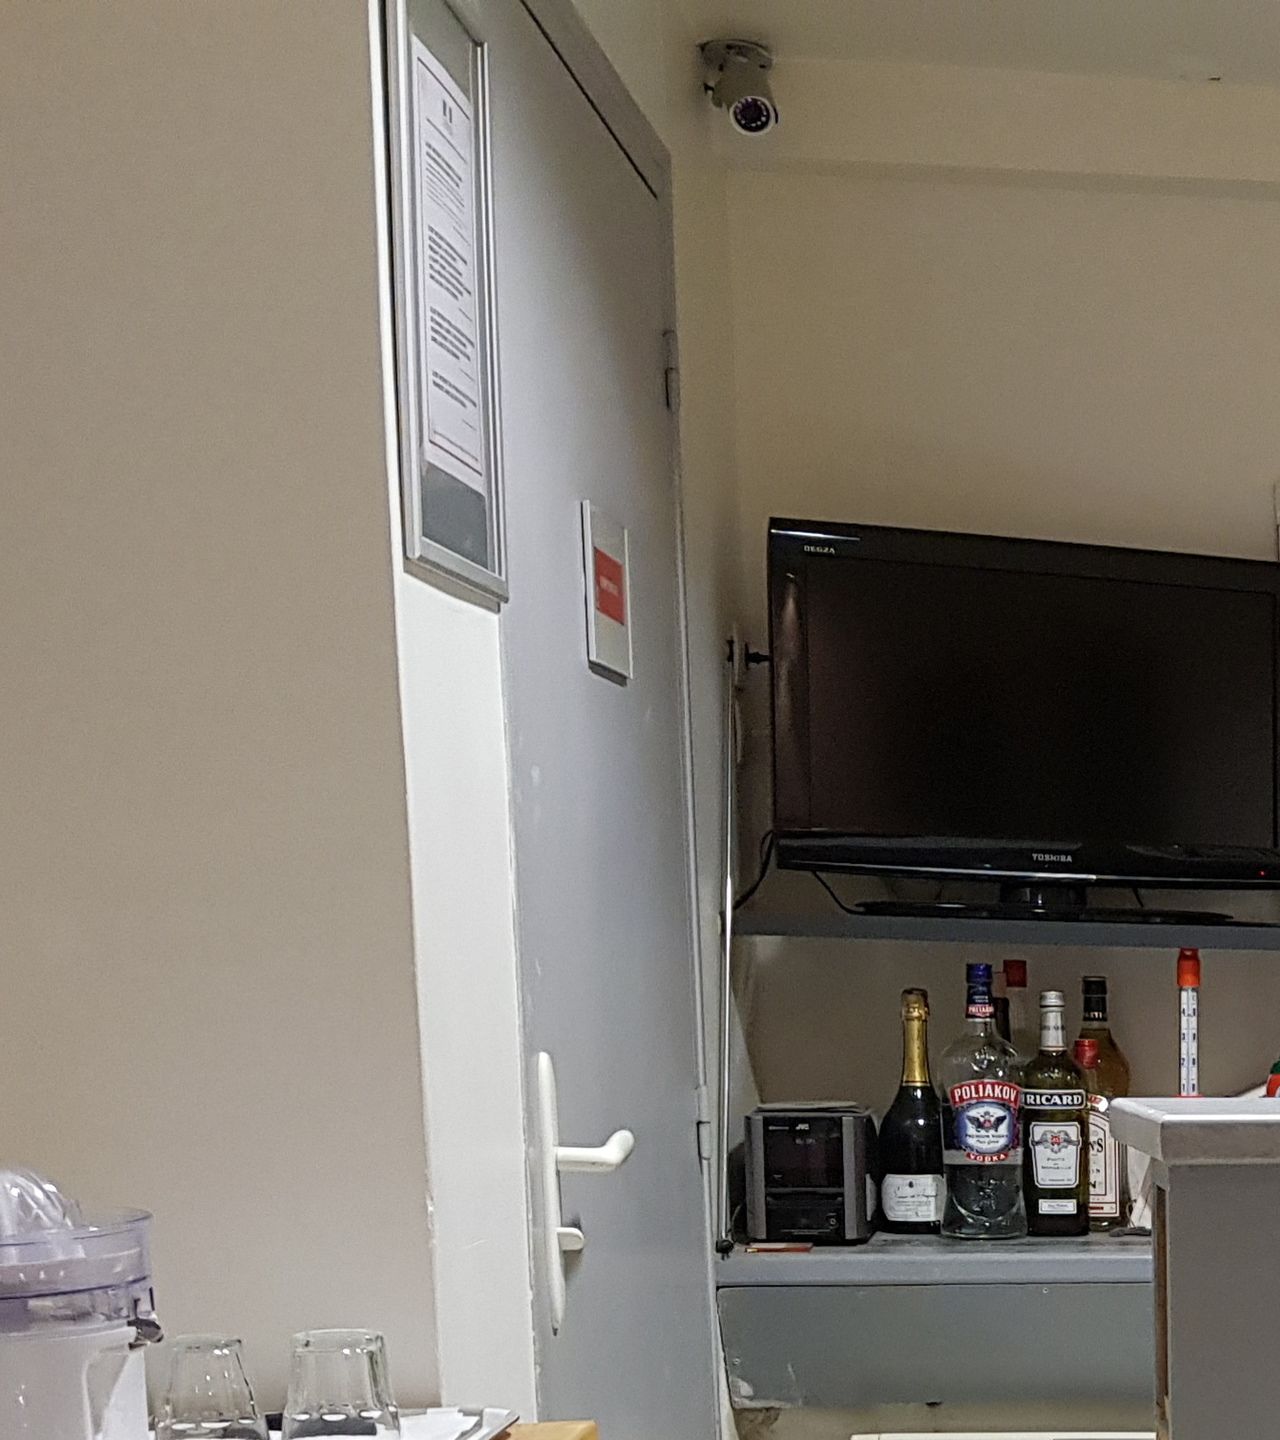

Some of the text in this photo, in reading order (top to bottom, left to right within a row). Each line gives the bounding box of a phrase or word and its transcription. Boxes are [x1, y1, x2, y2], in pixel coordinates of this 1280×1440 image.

[1031, 853, 1073, 863] TOSHIBA
[954, 1084, 1016, 1102] POLIAKOV
[1026, 1095, 1082, 1105] RICARD
[969, 1153, 1006, 1162] VODKA
